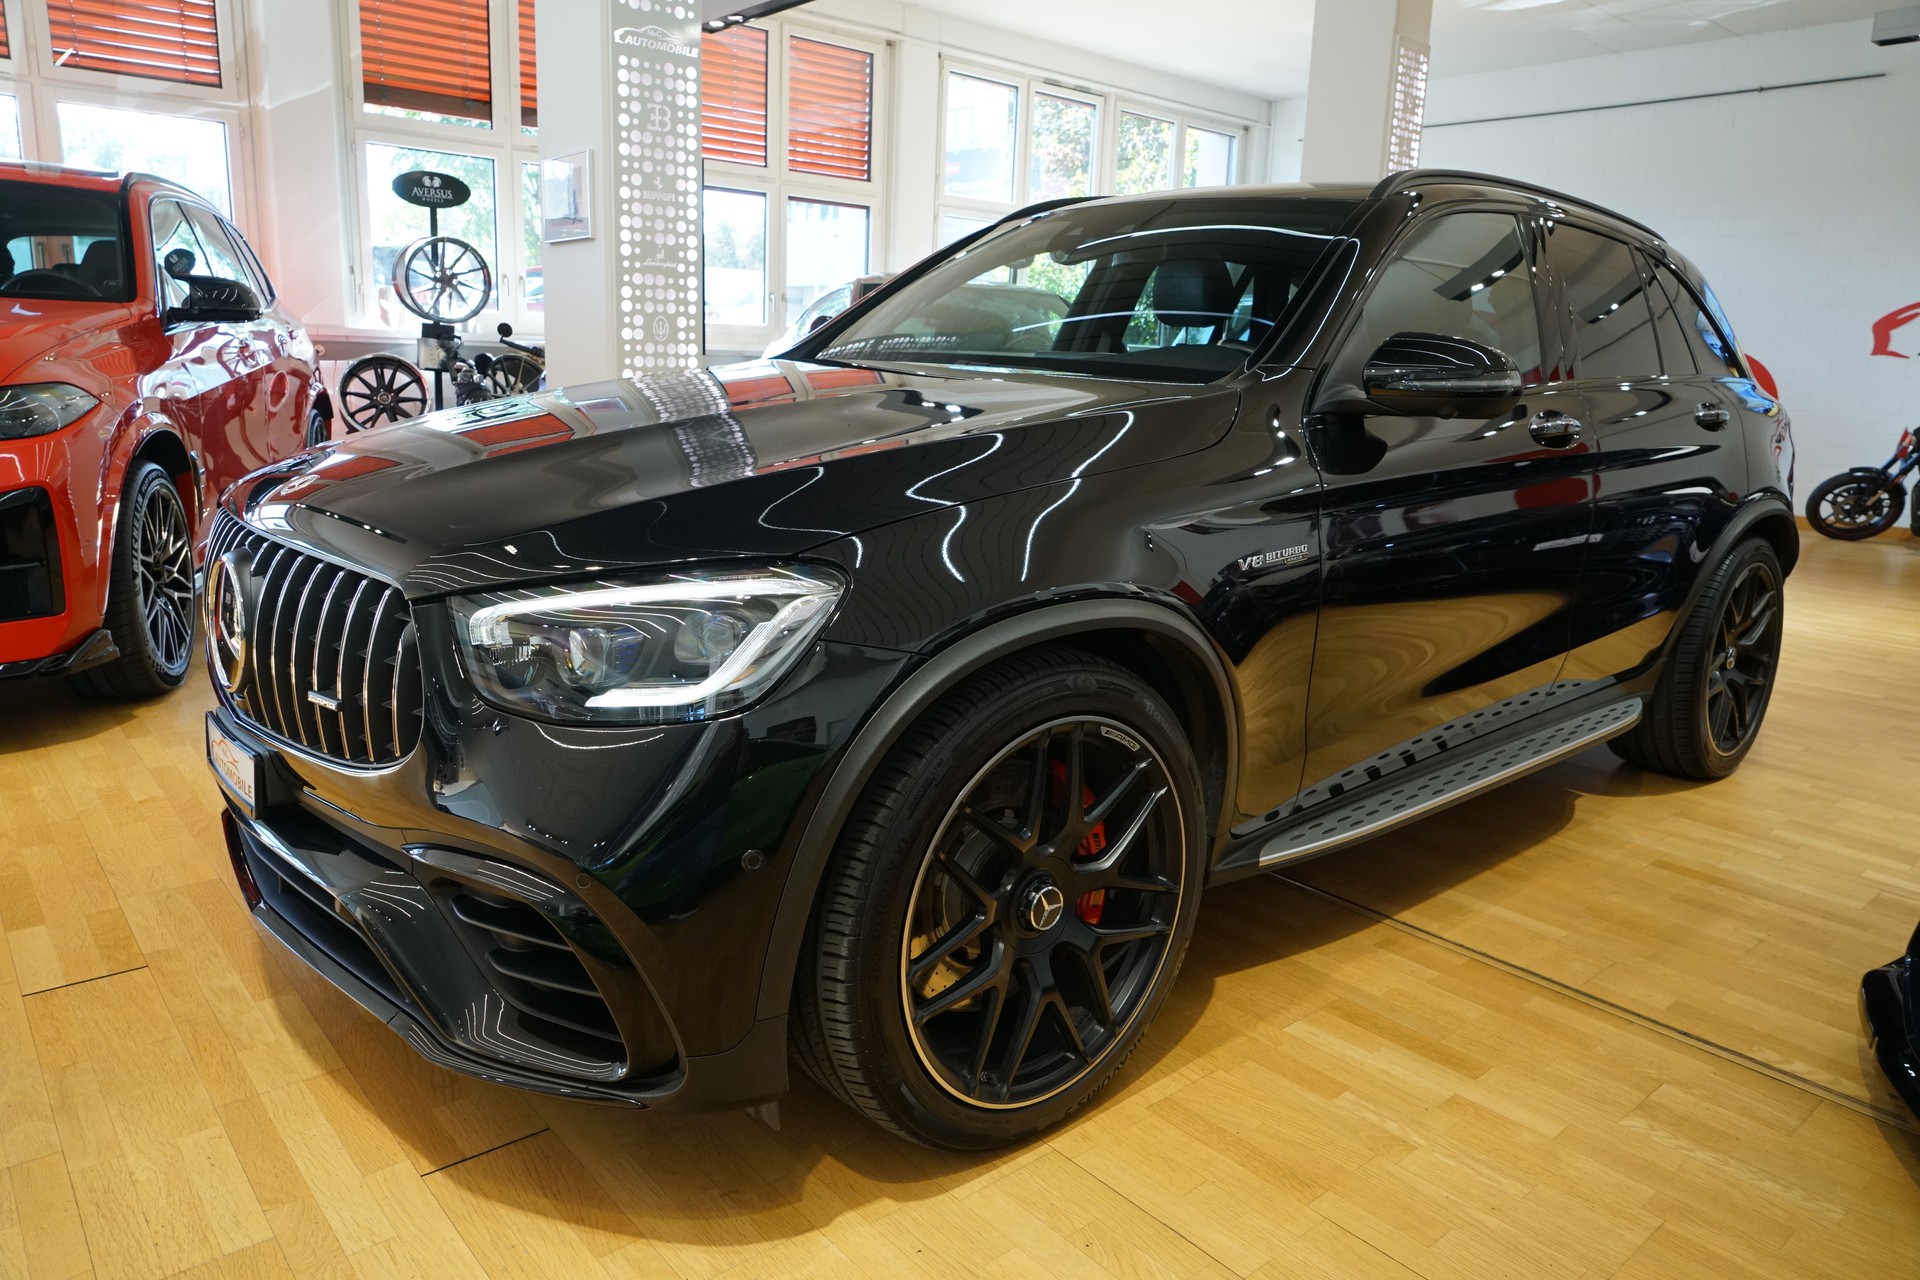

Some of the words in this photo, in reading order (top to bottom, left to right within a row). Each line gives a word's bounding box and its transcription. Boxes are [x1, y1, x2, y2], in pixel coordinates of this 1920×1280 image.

[624, 35, 699, 58] AUTOMOBILE
[411, 186, 453, 199] AVERSUS
[132, 493, 144, 573] MICHELIN
[1238, 555, 1264, 571] V8
[1265, 544, 1308, 561] BITURBO
